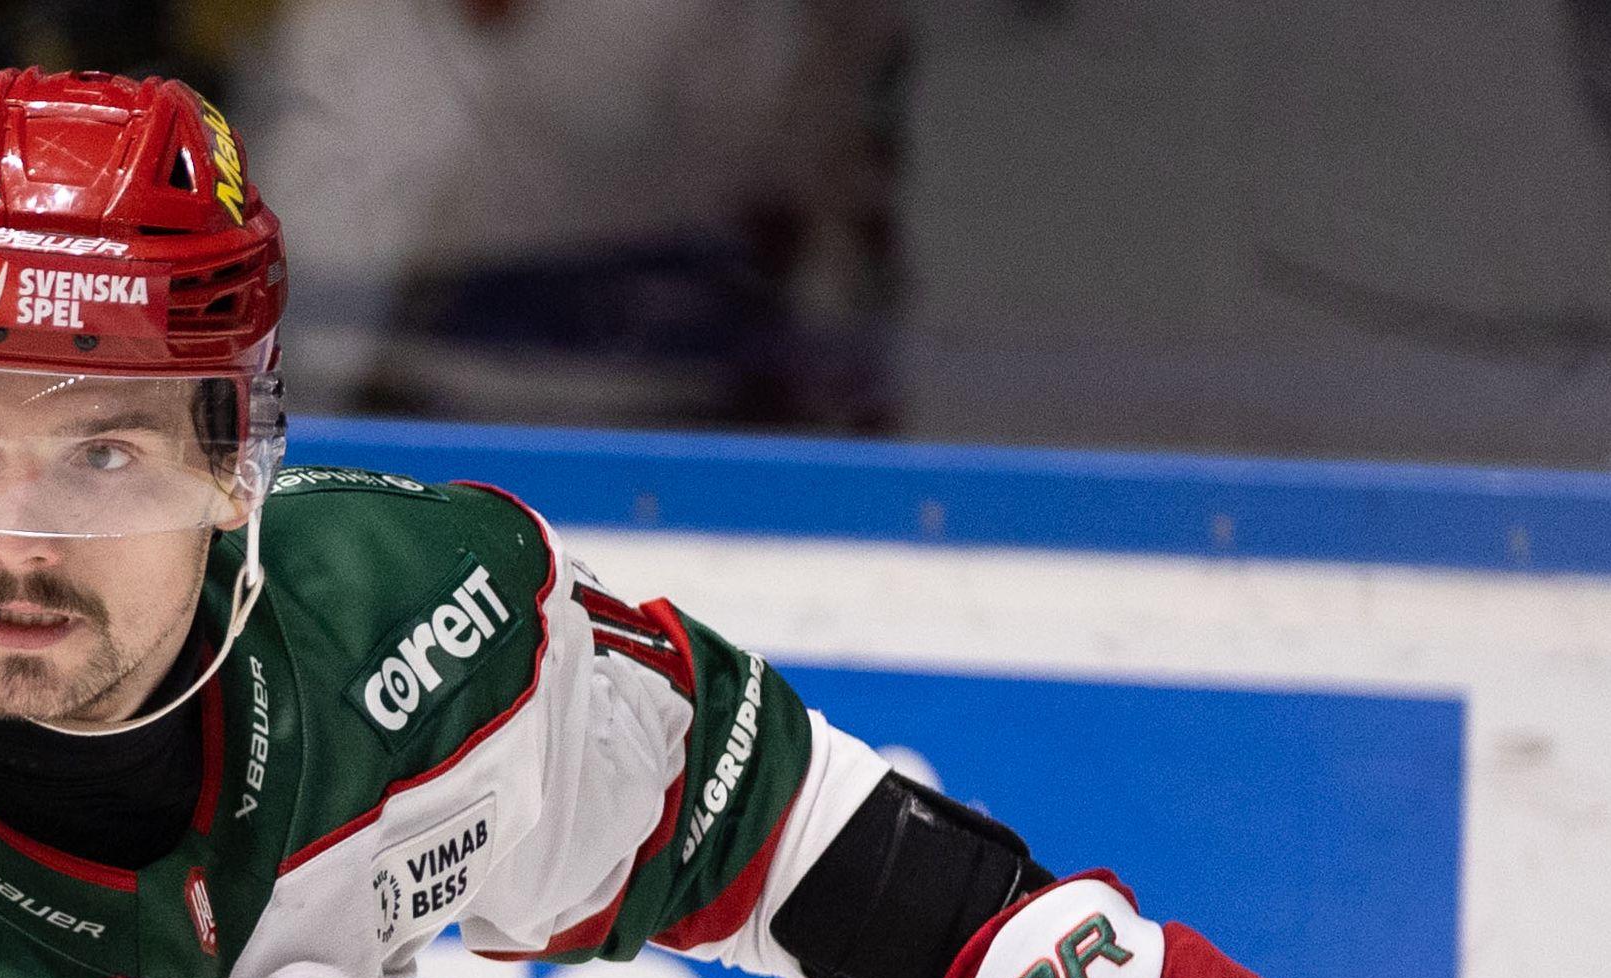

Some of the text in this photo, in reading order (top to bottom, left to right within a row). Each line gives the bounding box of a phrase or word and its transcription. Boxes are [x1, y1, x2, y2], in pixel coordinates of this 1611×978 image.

[16, 296, 84, 329] SPEL
[18, 267, 148, 305] SVENSKA
[682, 654, 765, 864] BILGRUPPE
[407, 820, 488, 883] VIMAB
[412, 866, 468, 919] BESS
